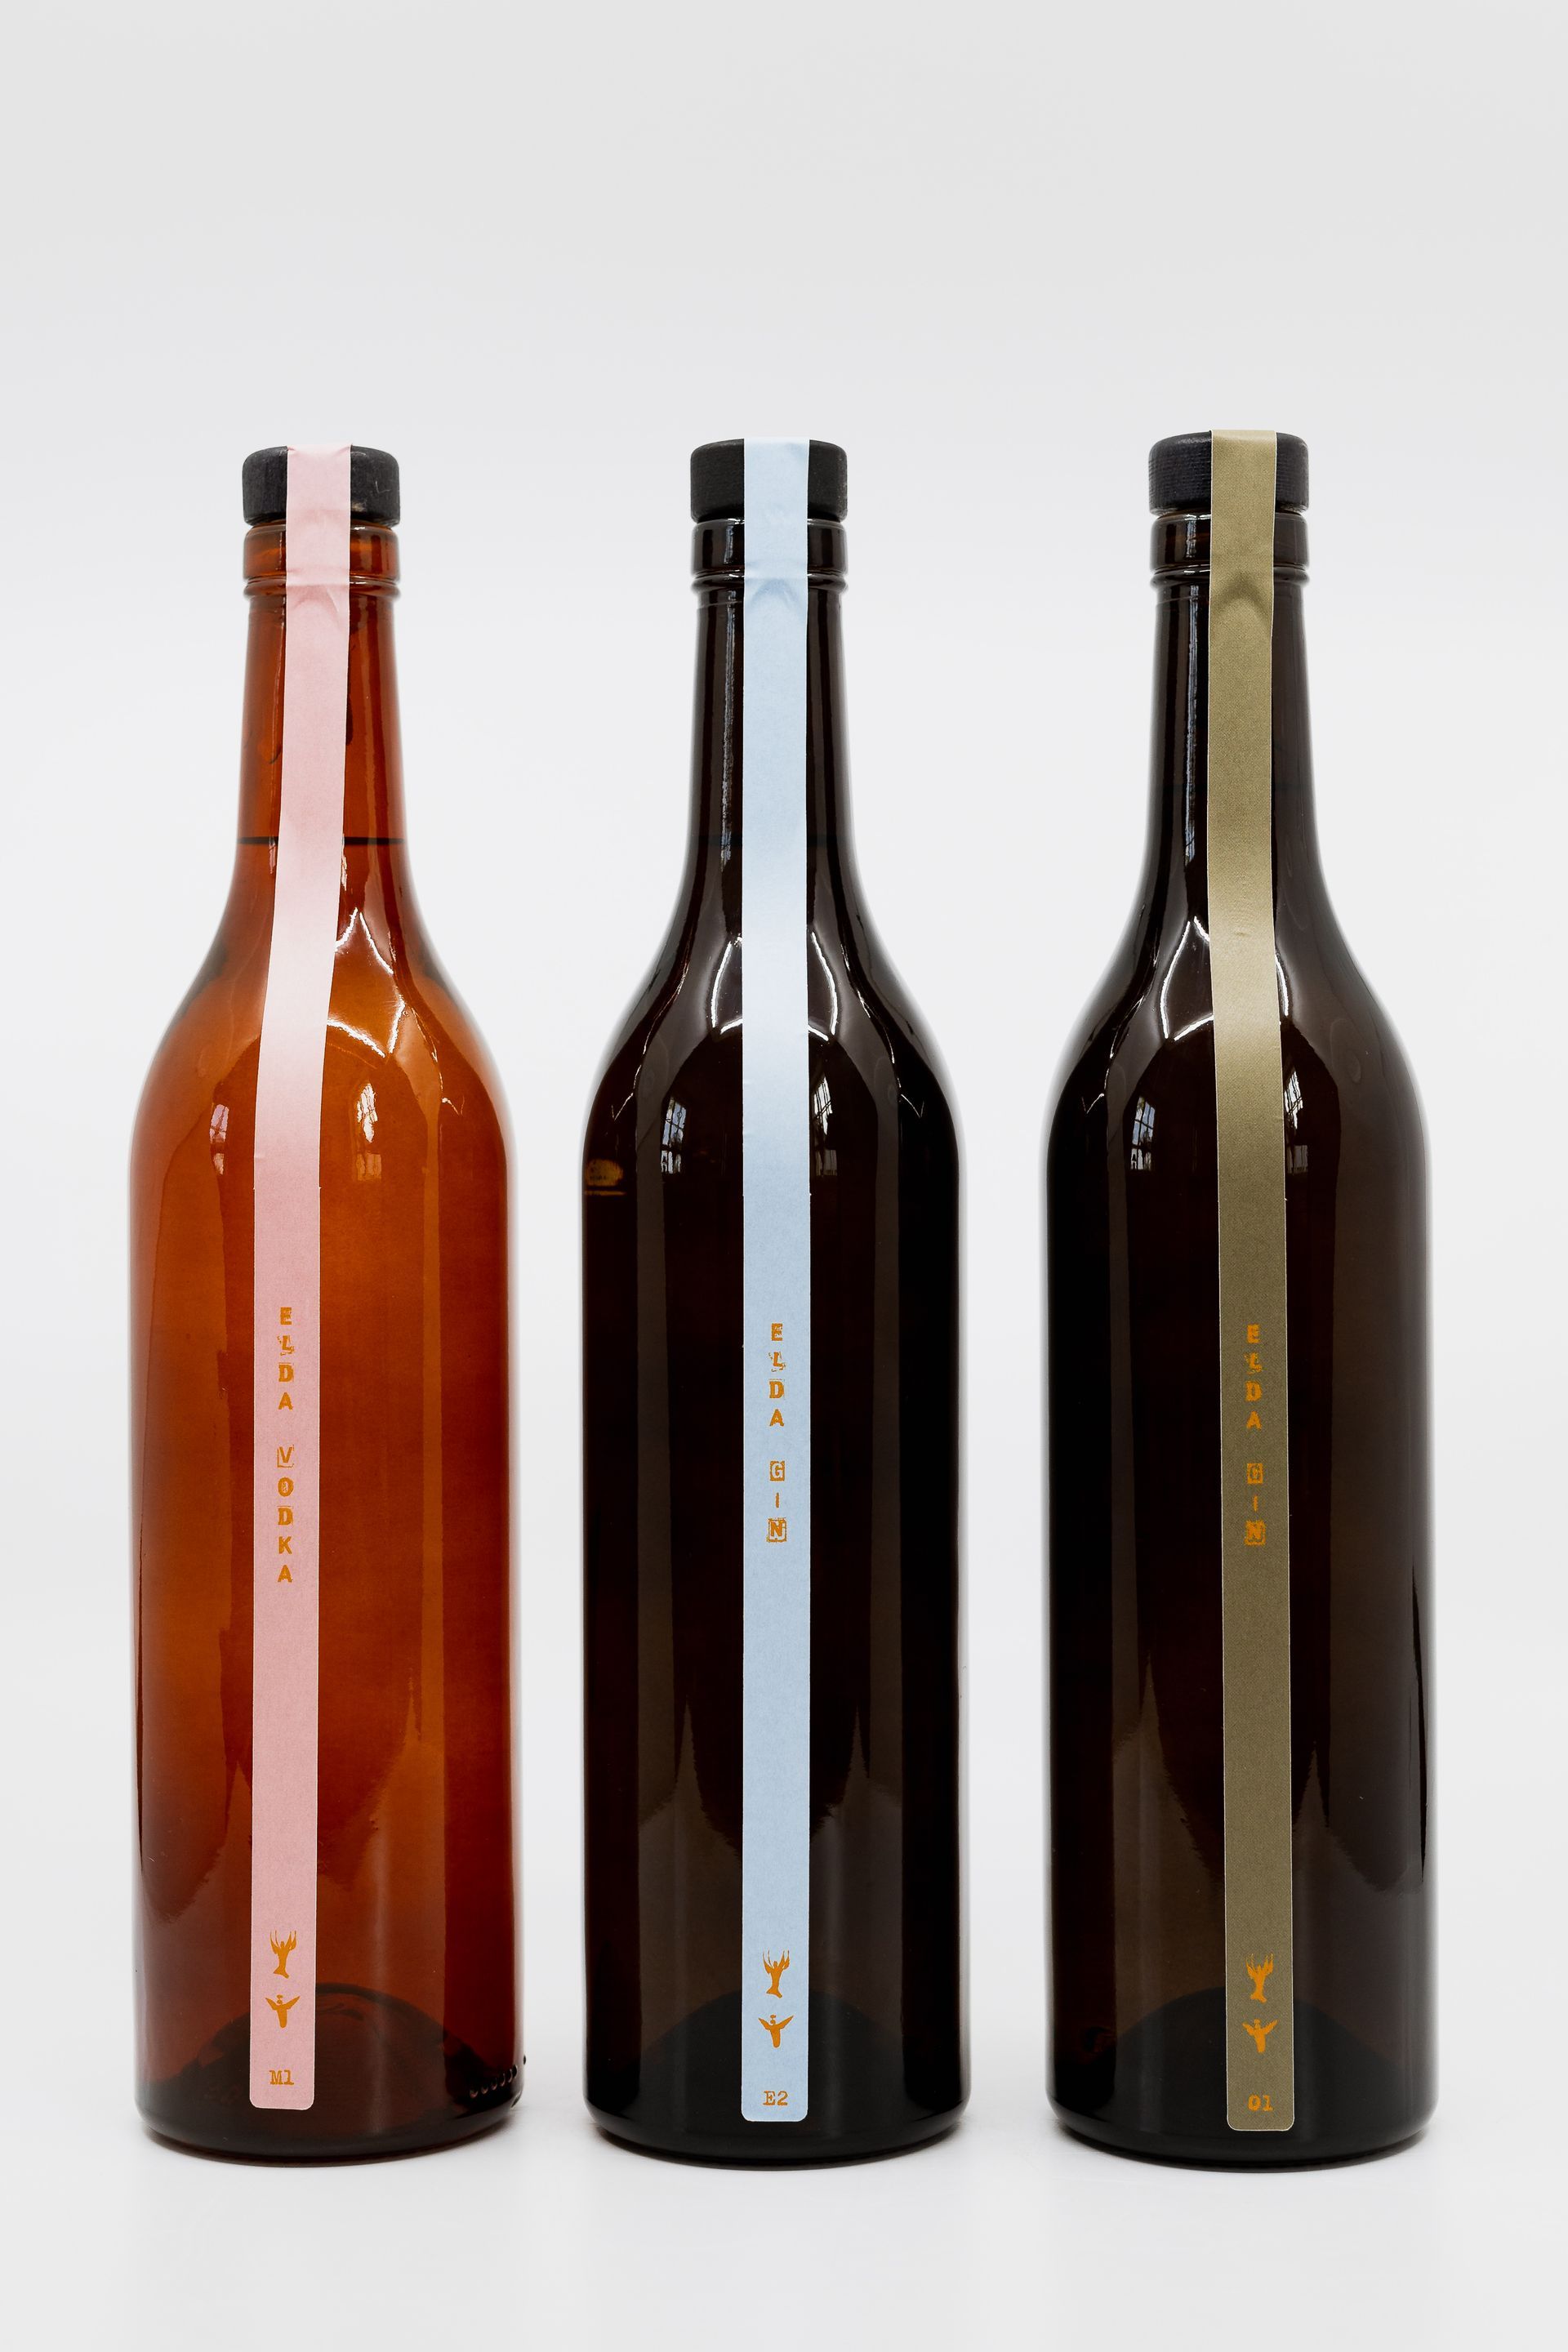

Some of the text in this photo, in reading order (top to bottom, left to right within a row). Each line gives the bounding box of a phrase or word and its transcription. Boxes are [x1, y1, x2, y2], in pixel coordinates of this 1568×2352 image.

[274, 1306, 296, 1584] ELDA VODKA
[766, 1322, 787, 1543] ELDA GIN
[1245, 1324, 1266, 1546] ELDA GIN
[764, 2090, 788, 2106] E2
